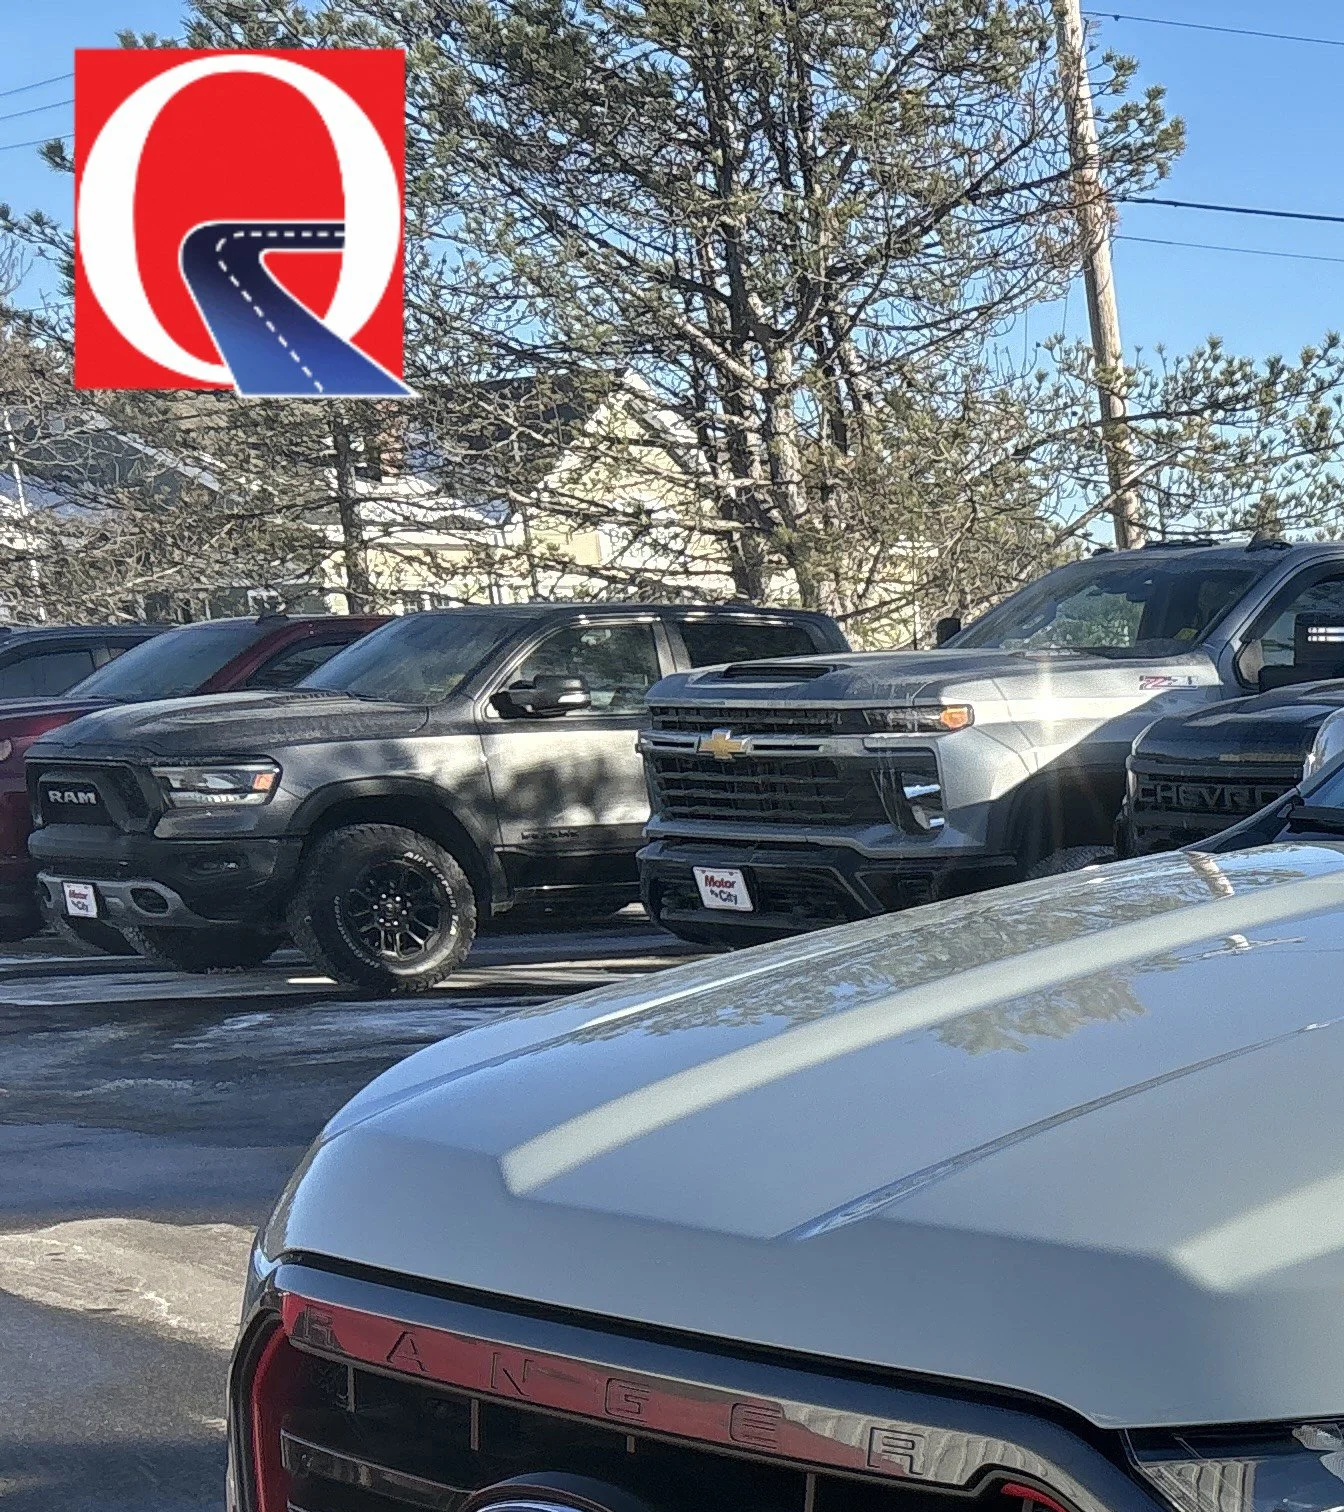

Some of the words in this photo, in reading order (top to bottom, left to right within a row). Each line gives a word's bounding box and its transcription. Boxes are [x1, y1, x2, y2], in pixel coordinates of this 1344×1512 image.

[48, 790, 97, 805] RAM
[704, 874, 737, 889] Motor
[302, 1303, 928, 1475] RANGER
